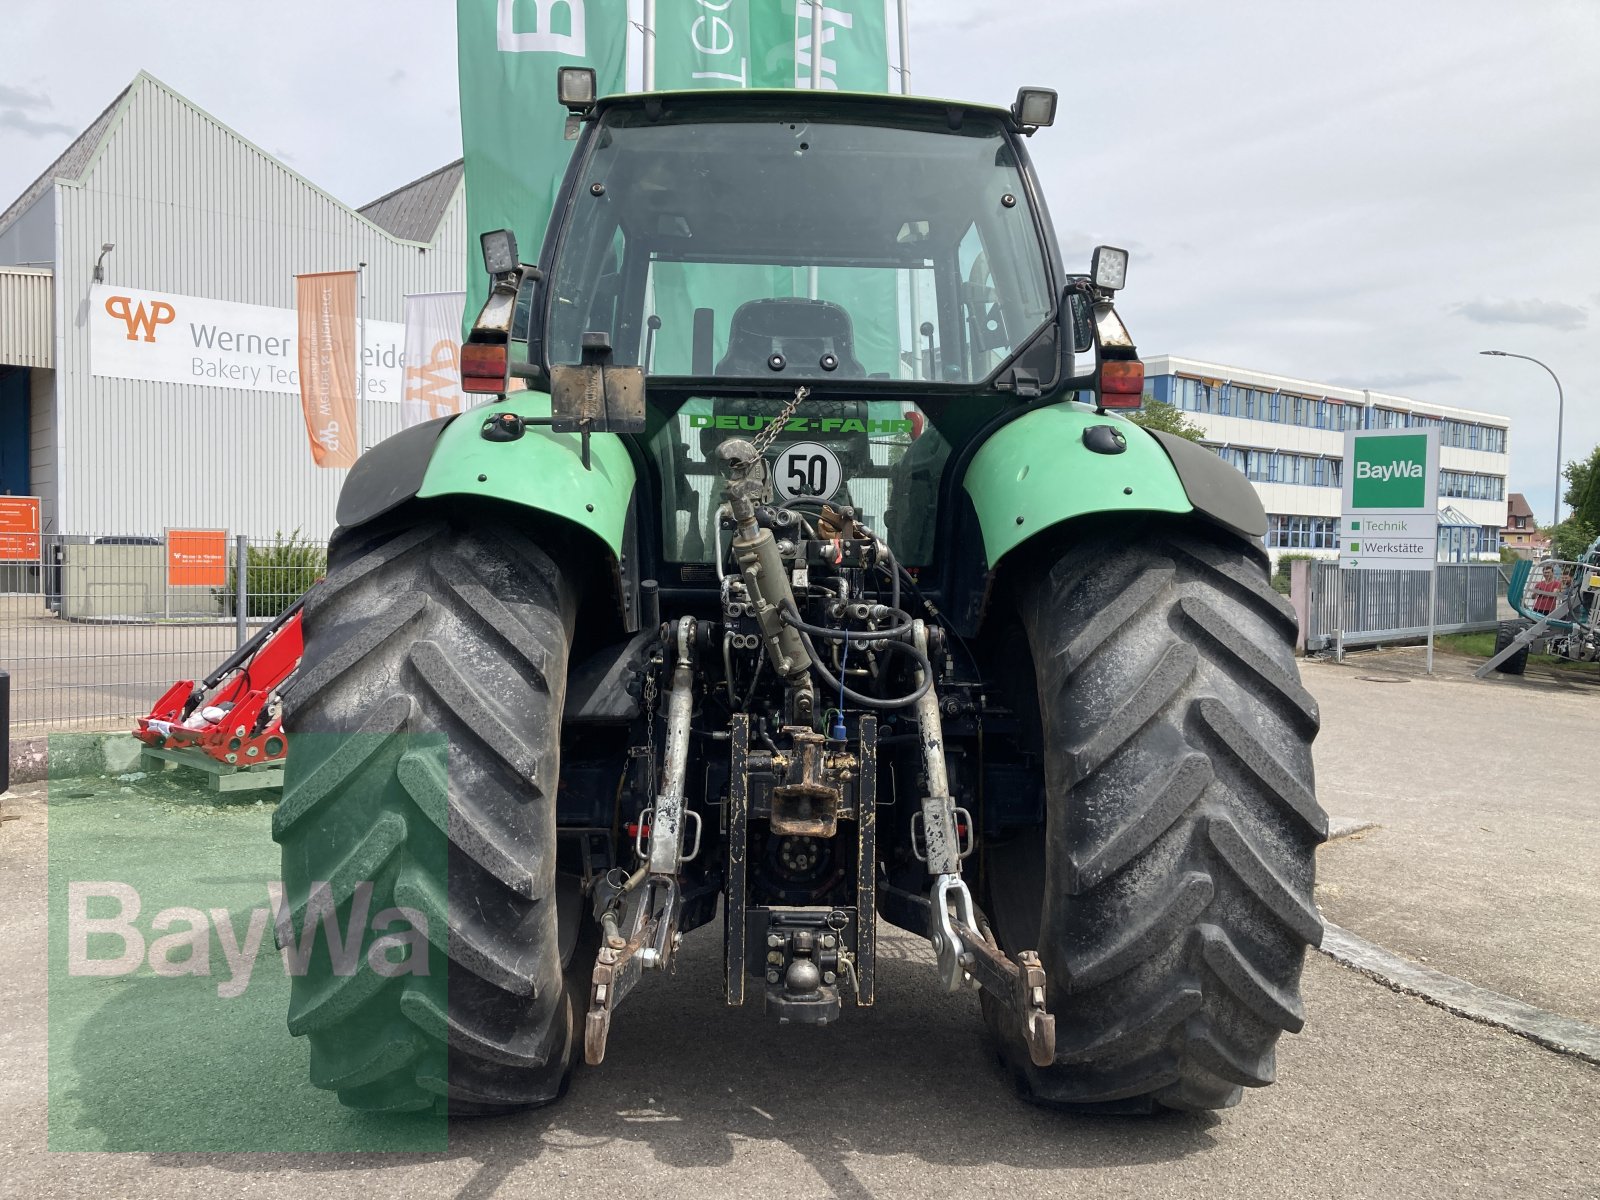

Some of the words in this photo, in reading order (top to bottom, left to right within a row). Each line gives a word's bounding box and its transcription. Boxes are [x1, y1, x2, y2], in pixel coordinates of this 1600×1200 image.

[190, 323, 291, 357] Werner
[192, 357, 261, 386] Bakery
[689, 415, 913, 433] DEUTZ-FAHR
[787, 454, 828, 497] 50
[1356, 460, 1423, 482] BayWa
[1365, 521, 1407, 532] Technik
[1364, 542, 1424, 554] Werkstätte
